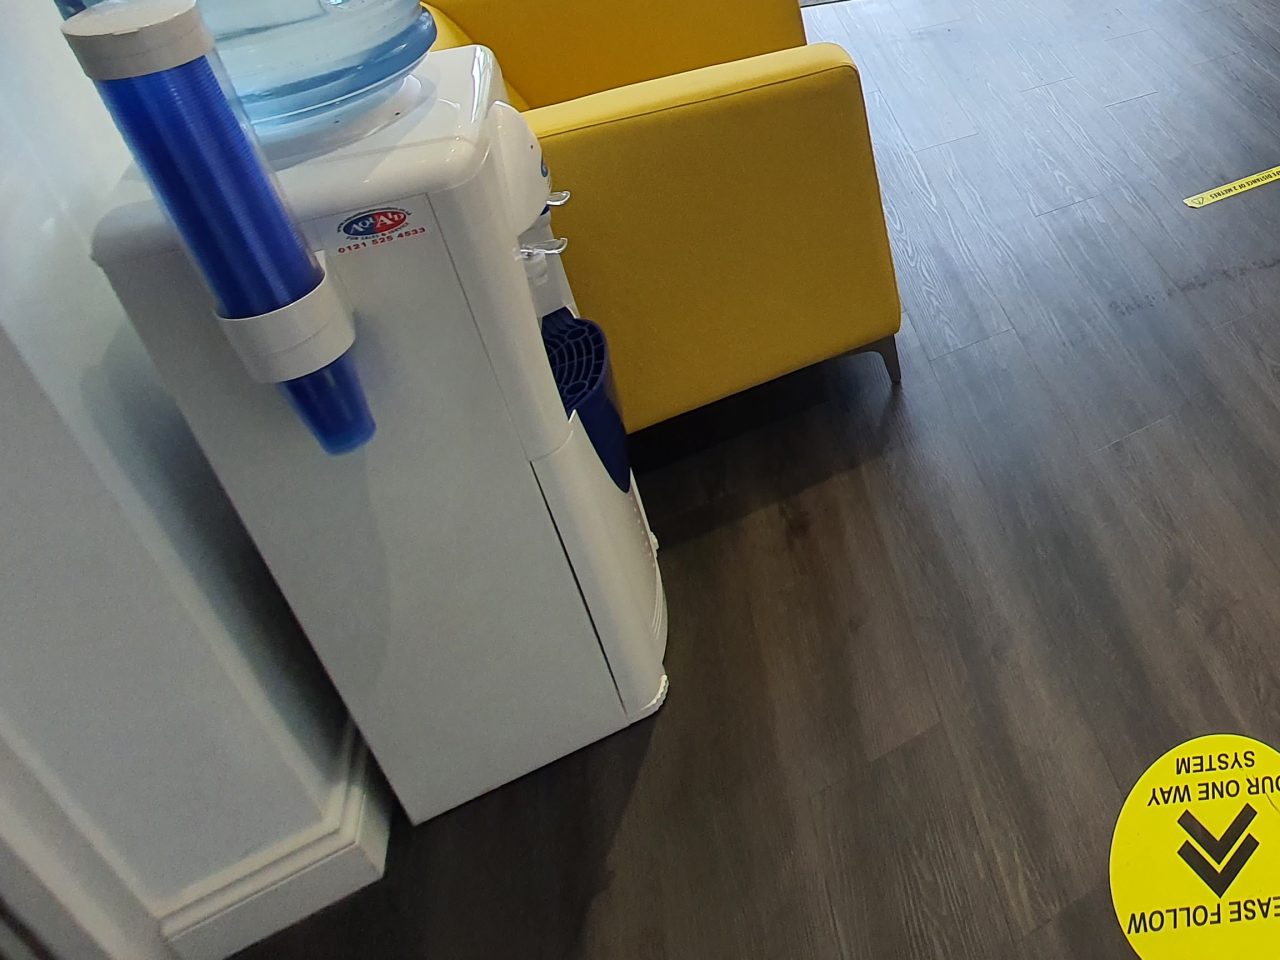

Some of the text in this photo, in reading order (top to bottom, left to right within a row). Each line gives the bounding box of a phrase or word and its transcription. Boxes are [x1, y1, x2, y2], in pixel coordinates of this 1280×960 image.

[1245, 173, 1273, 187] DISTANCE
[1209, 187, 1233, 199] METRES
[338, 242, 367, 253] 0121
[1175, 750, 1256, 775] SYSTEM
[1147, 784, 1192, 807] WAY
[1197, 779, 1240, 801] ONE
[1127, 903, 1222, 935] FOLLOW
